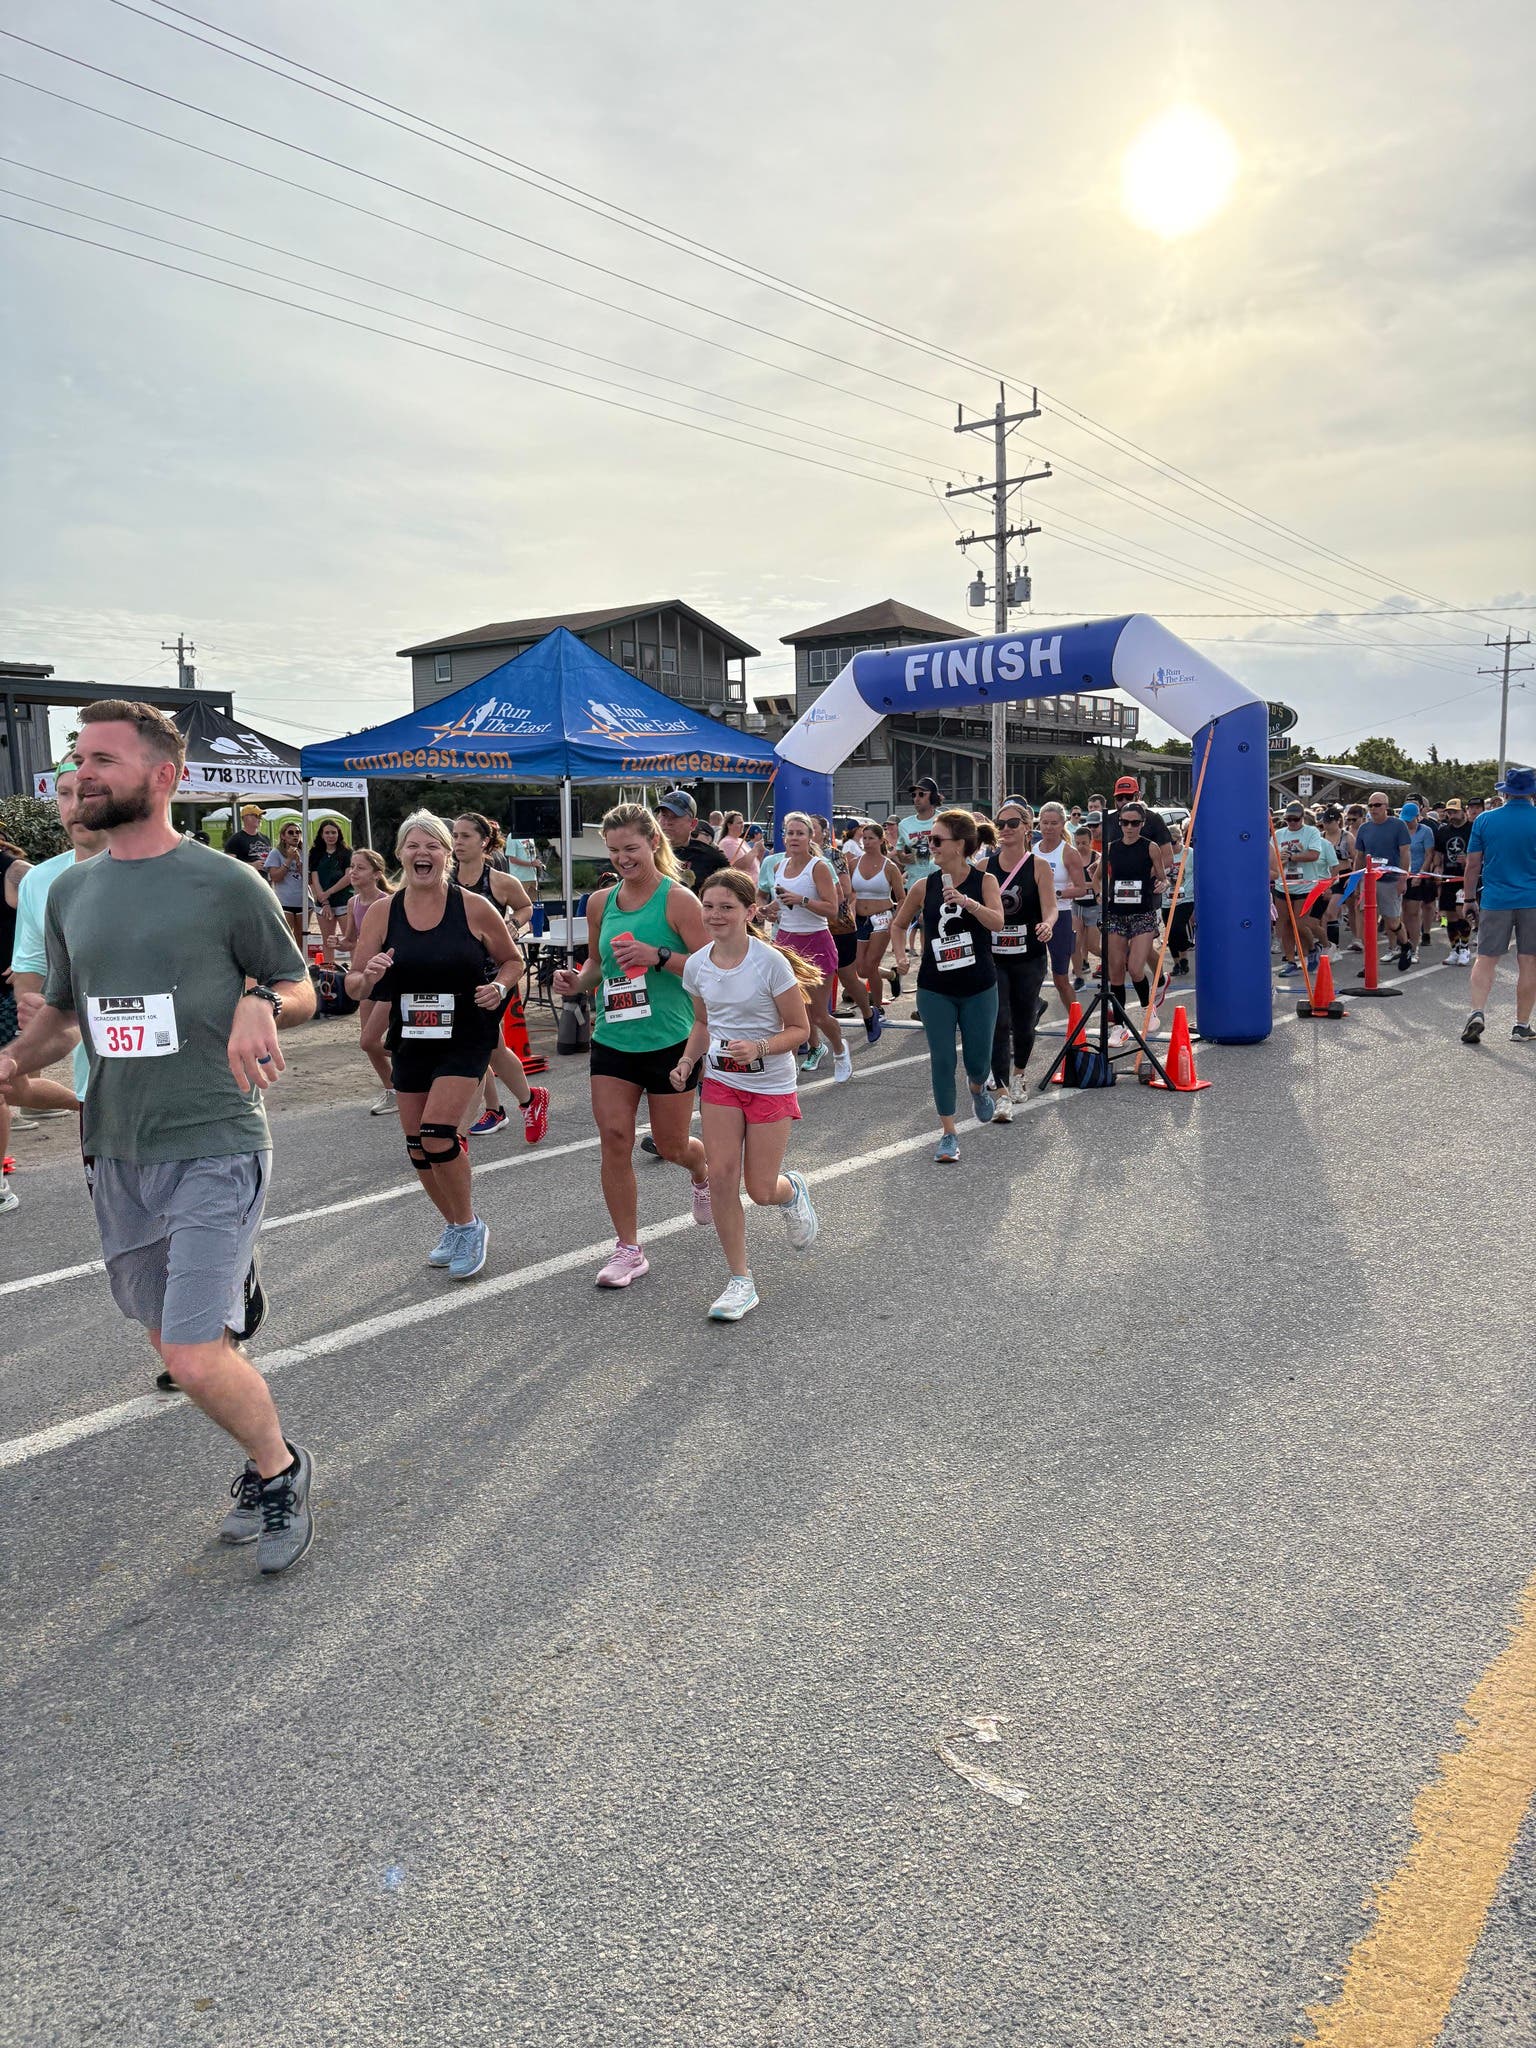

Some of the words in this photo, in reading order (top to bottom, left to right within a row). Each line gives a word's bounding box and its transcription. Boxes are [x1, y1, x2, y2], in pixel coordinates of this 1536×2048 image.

[905, 635, 1063, 692] FINISH
[496, 702, 531, 720] Run
[608, 703, 648, 719] Run
[483, 718, 510, 733] The
[511, 721, 551, 734] East
[621, 718, 652, 732] The
[650, 719, 689, 733] East
[621, 752, 774, 775] runtheeast.com
[202, 767, 233, 783] 1718
[235, 768, 314, 787] BREWIN
[317, 780, 354, 789] OCRACOKE
[944, 947, 962, 961] 267
[612, 992, 633, 1009] 233
[415, 1011, 439, 1026] 226
[106, 1026, 145, 1052] 357
